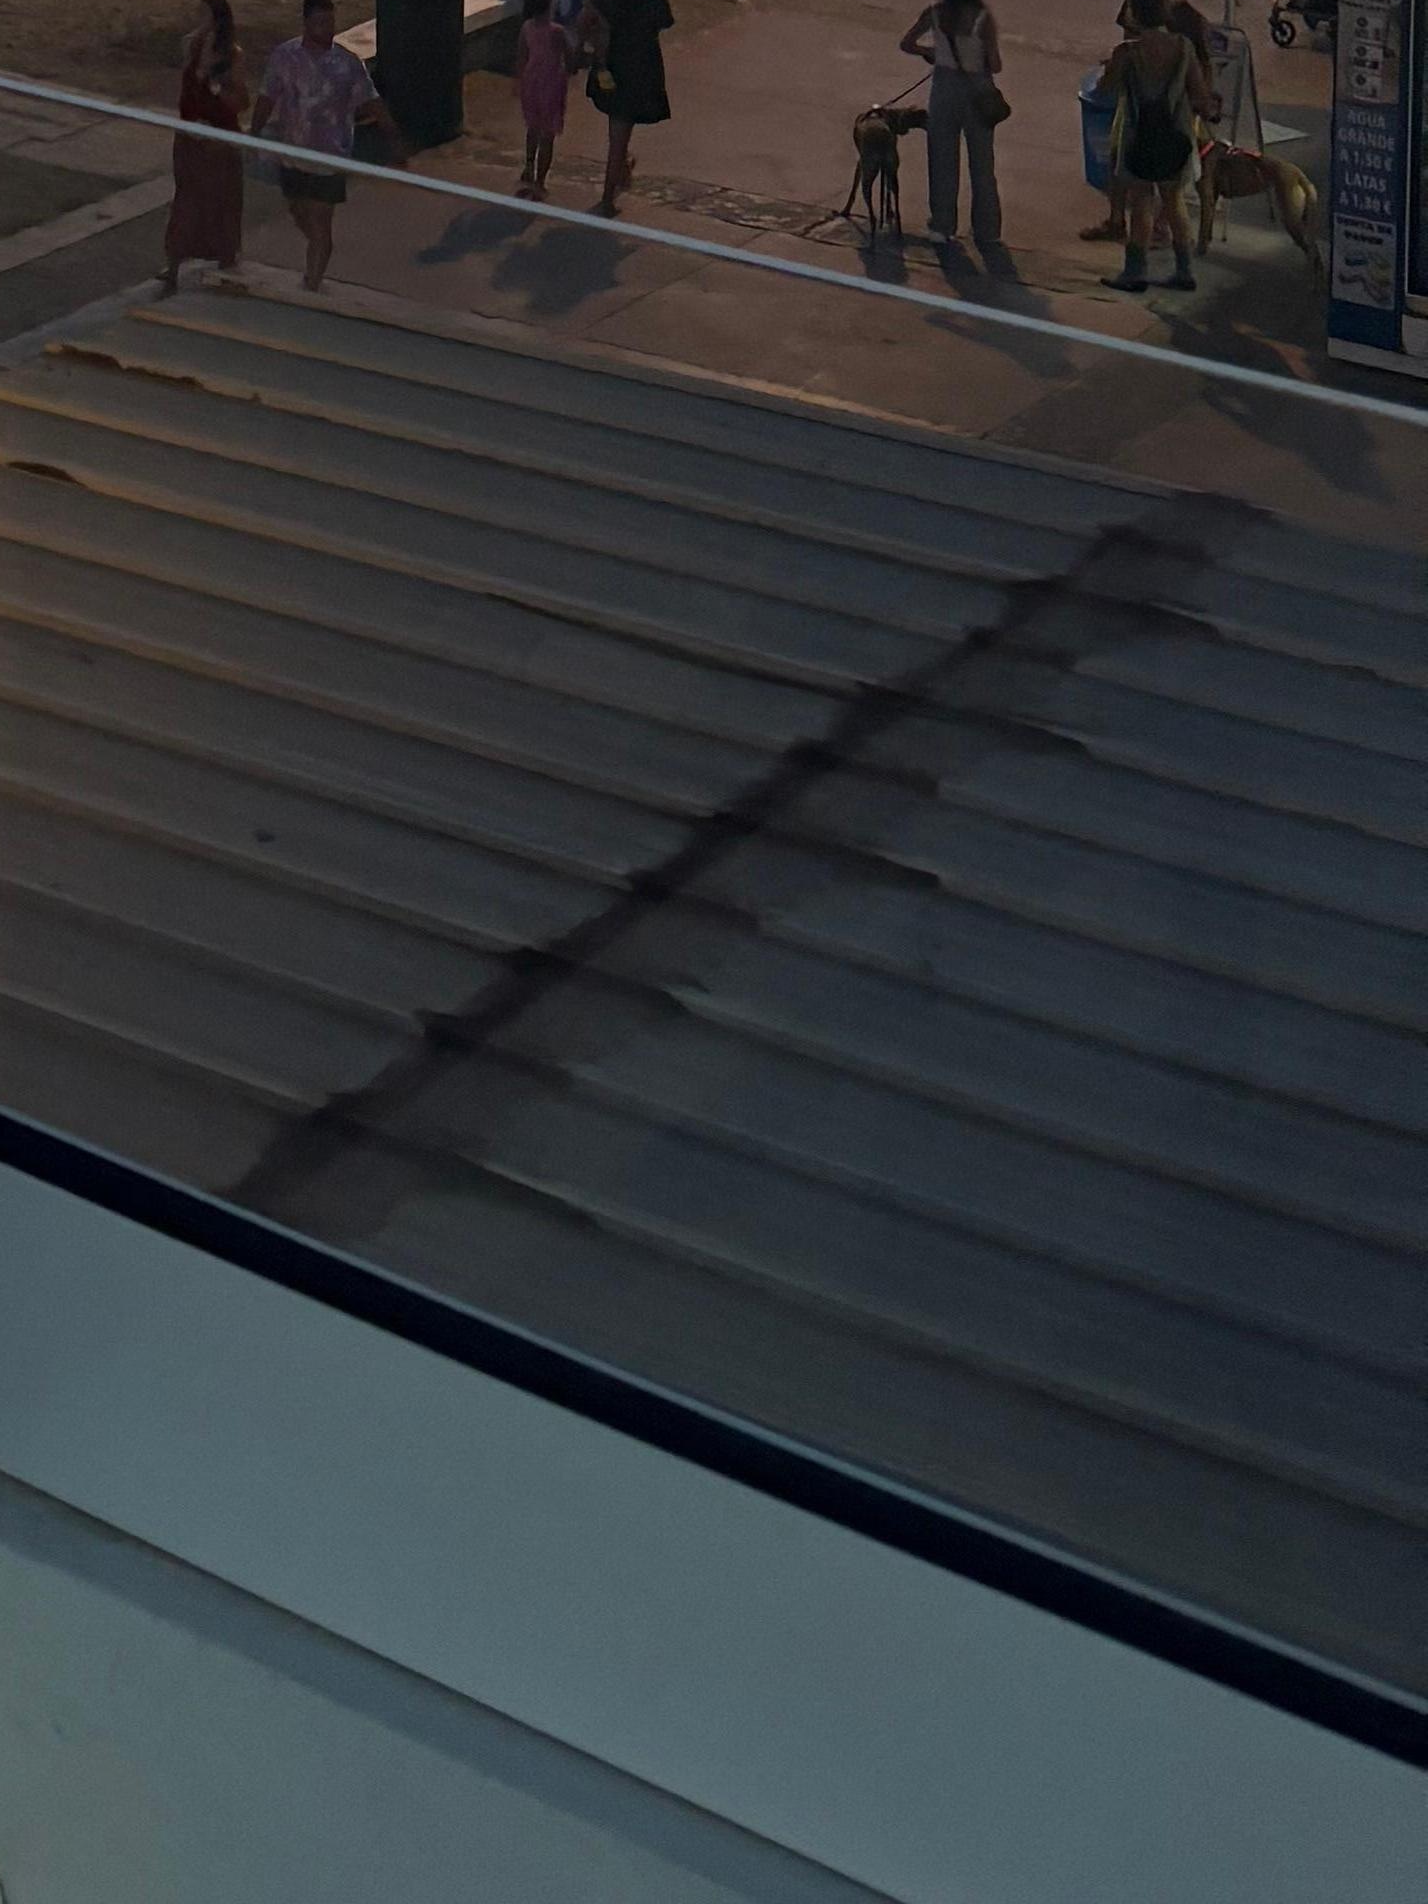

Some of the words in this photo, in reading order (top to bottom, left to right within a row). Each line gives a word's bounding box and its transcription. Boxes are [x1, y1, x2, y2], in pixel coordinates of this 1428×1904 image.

[1347, 109, 1386, 129] AGUA
[1337, 127, 1395, 152] GRANDE
[1345, 171, 1387, 192] LATAS
